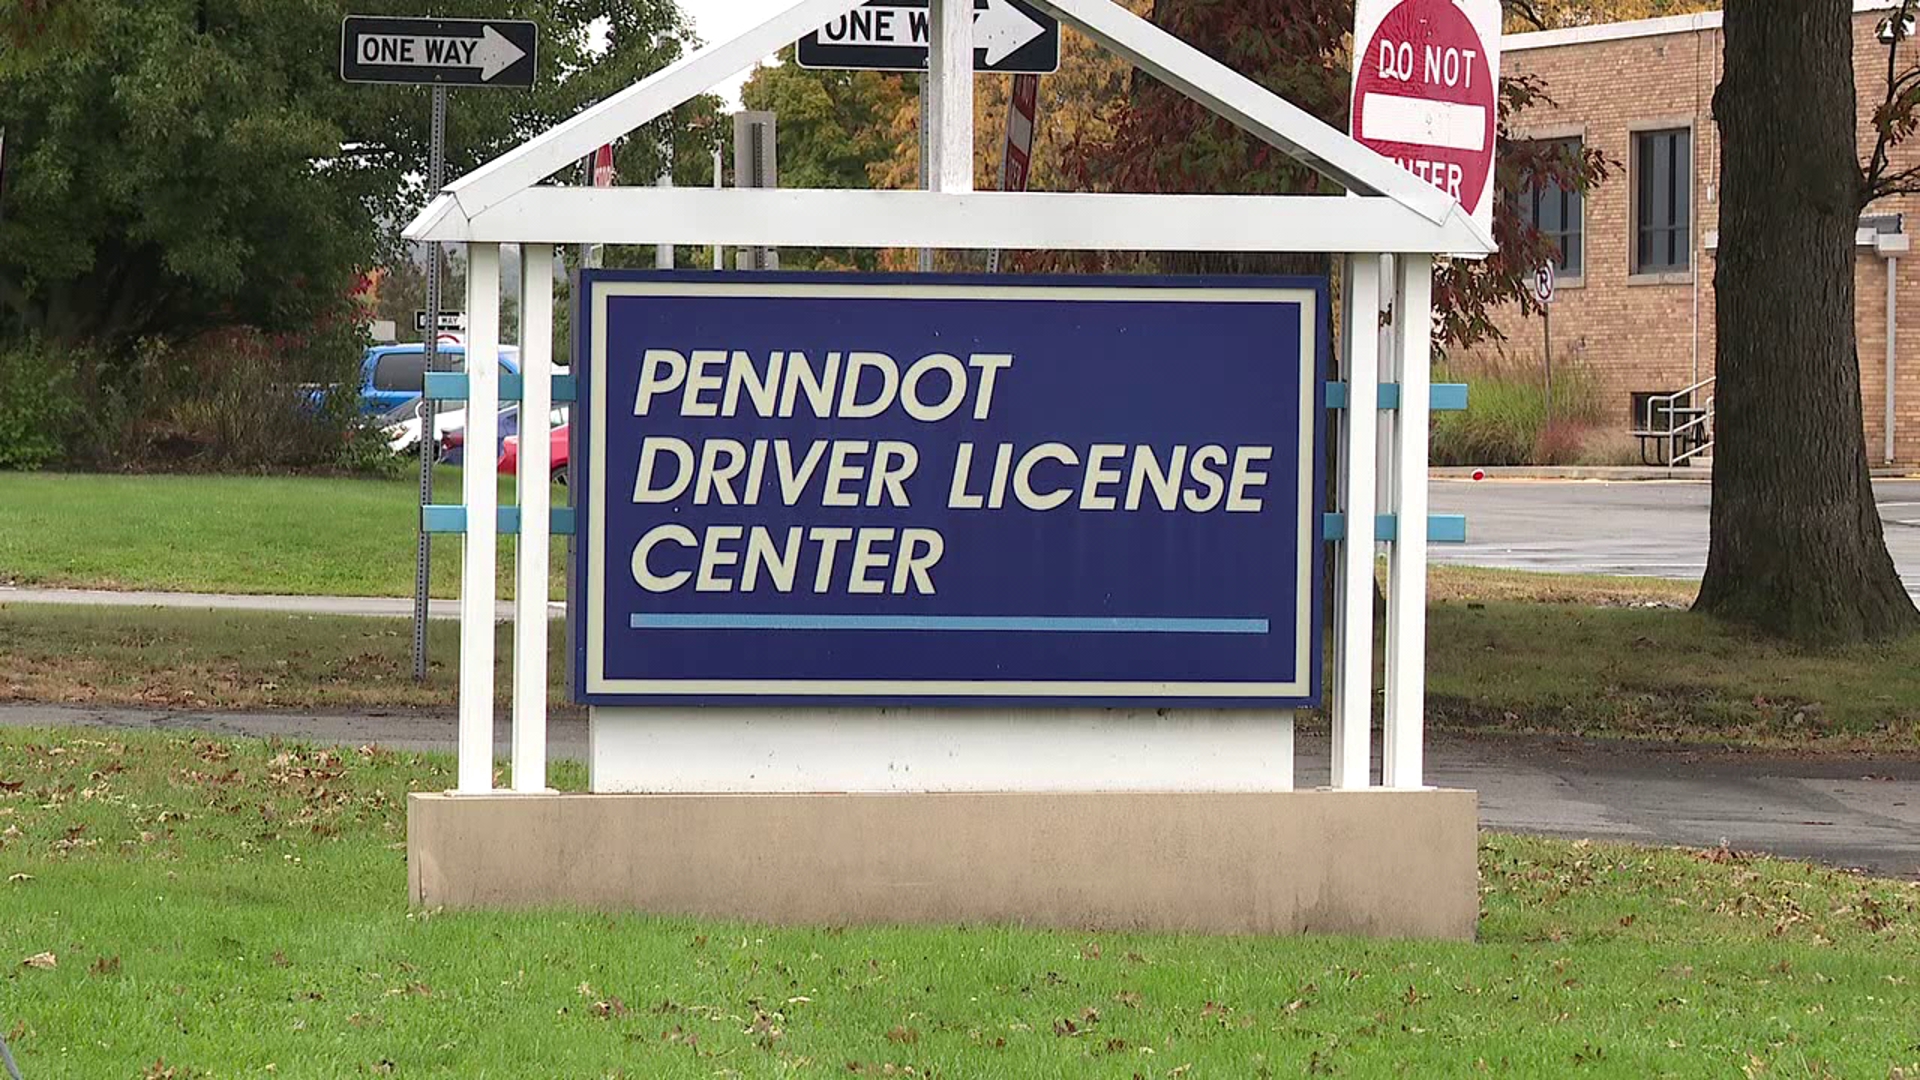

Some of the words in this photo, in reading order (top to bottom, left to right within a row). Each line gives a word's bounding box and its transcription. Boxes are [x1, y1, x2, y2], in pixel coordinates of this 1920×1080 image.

[362, 37, 415, 63] ONE
[425, 38, 478, 65] WAY
[824, 10, 895, 42] ONE
[1379, 38, 1414, 82] DO
[1424, 45, 1476, 88] NOT
[633, 349, 1013, 421] PENNDOT
[632, 437, 918, 507] DRIVER
[948, 443, 1273, 512] LICENSE
[631, 524, 944, 594] CENTER
